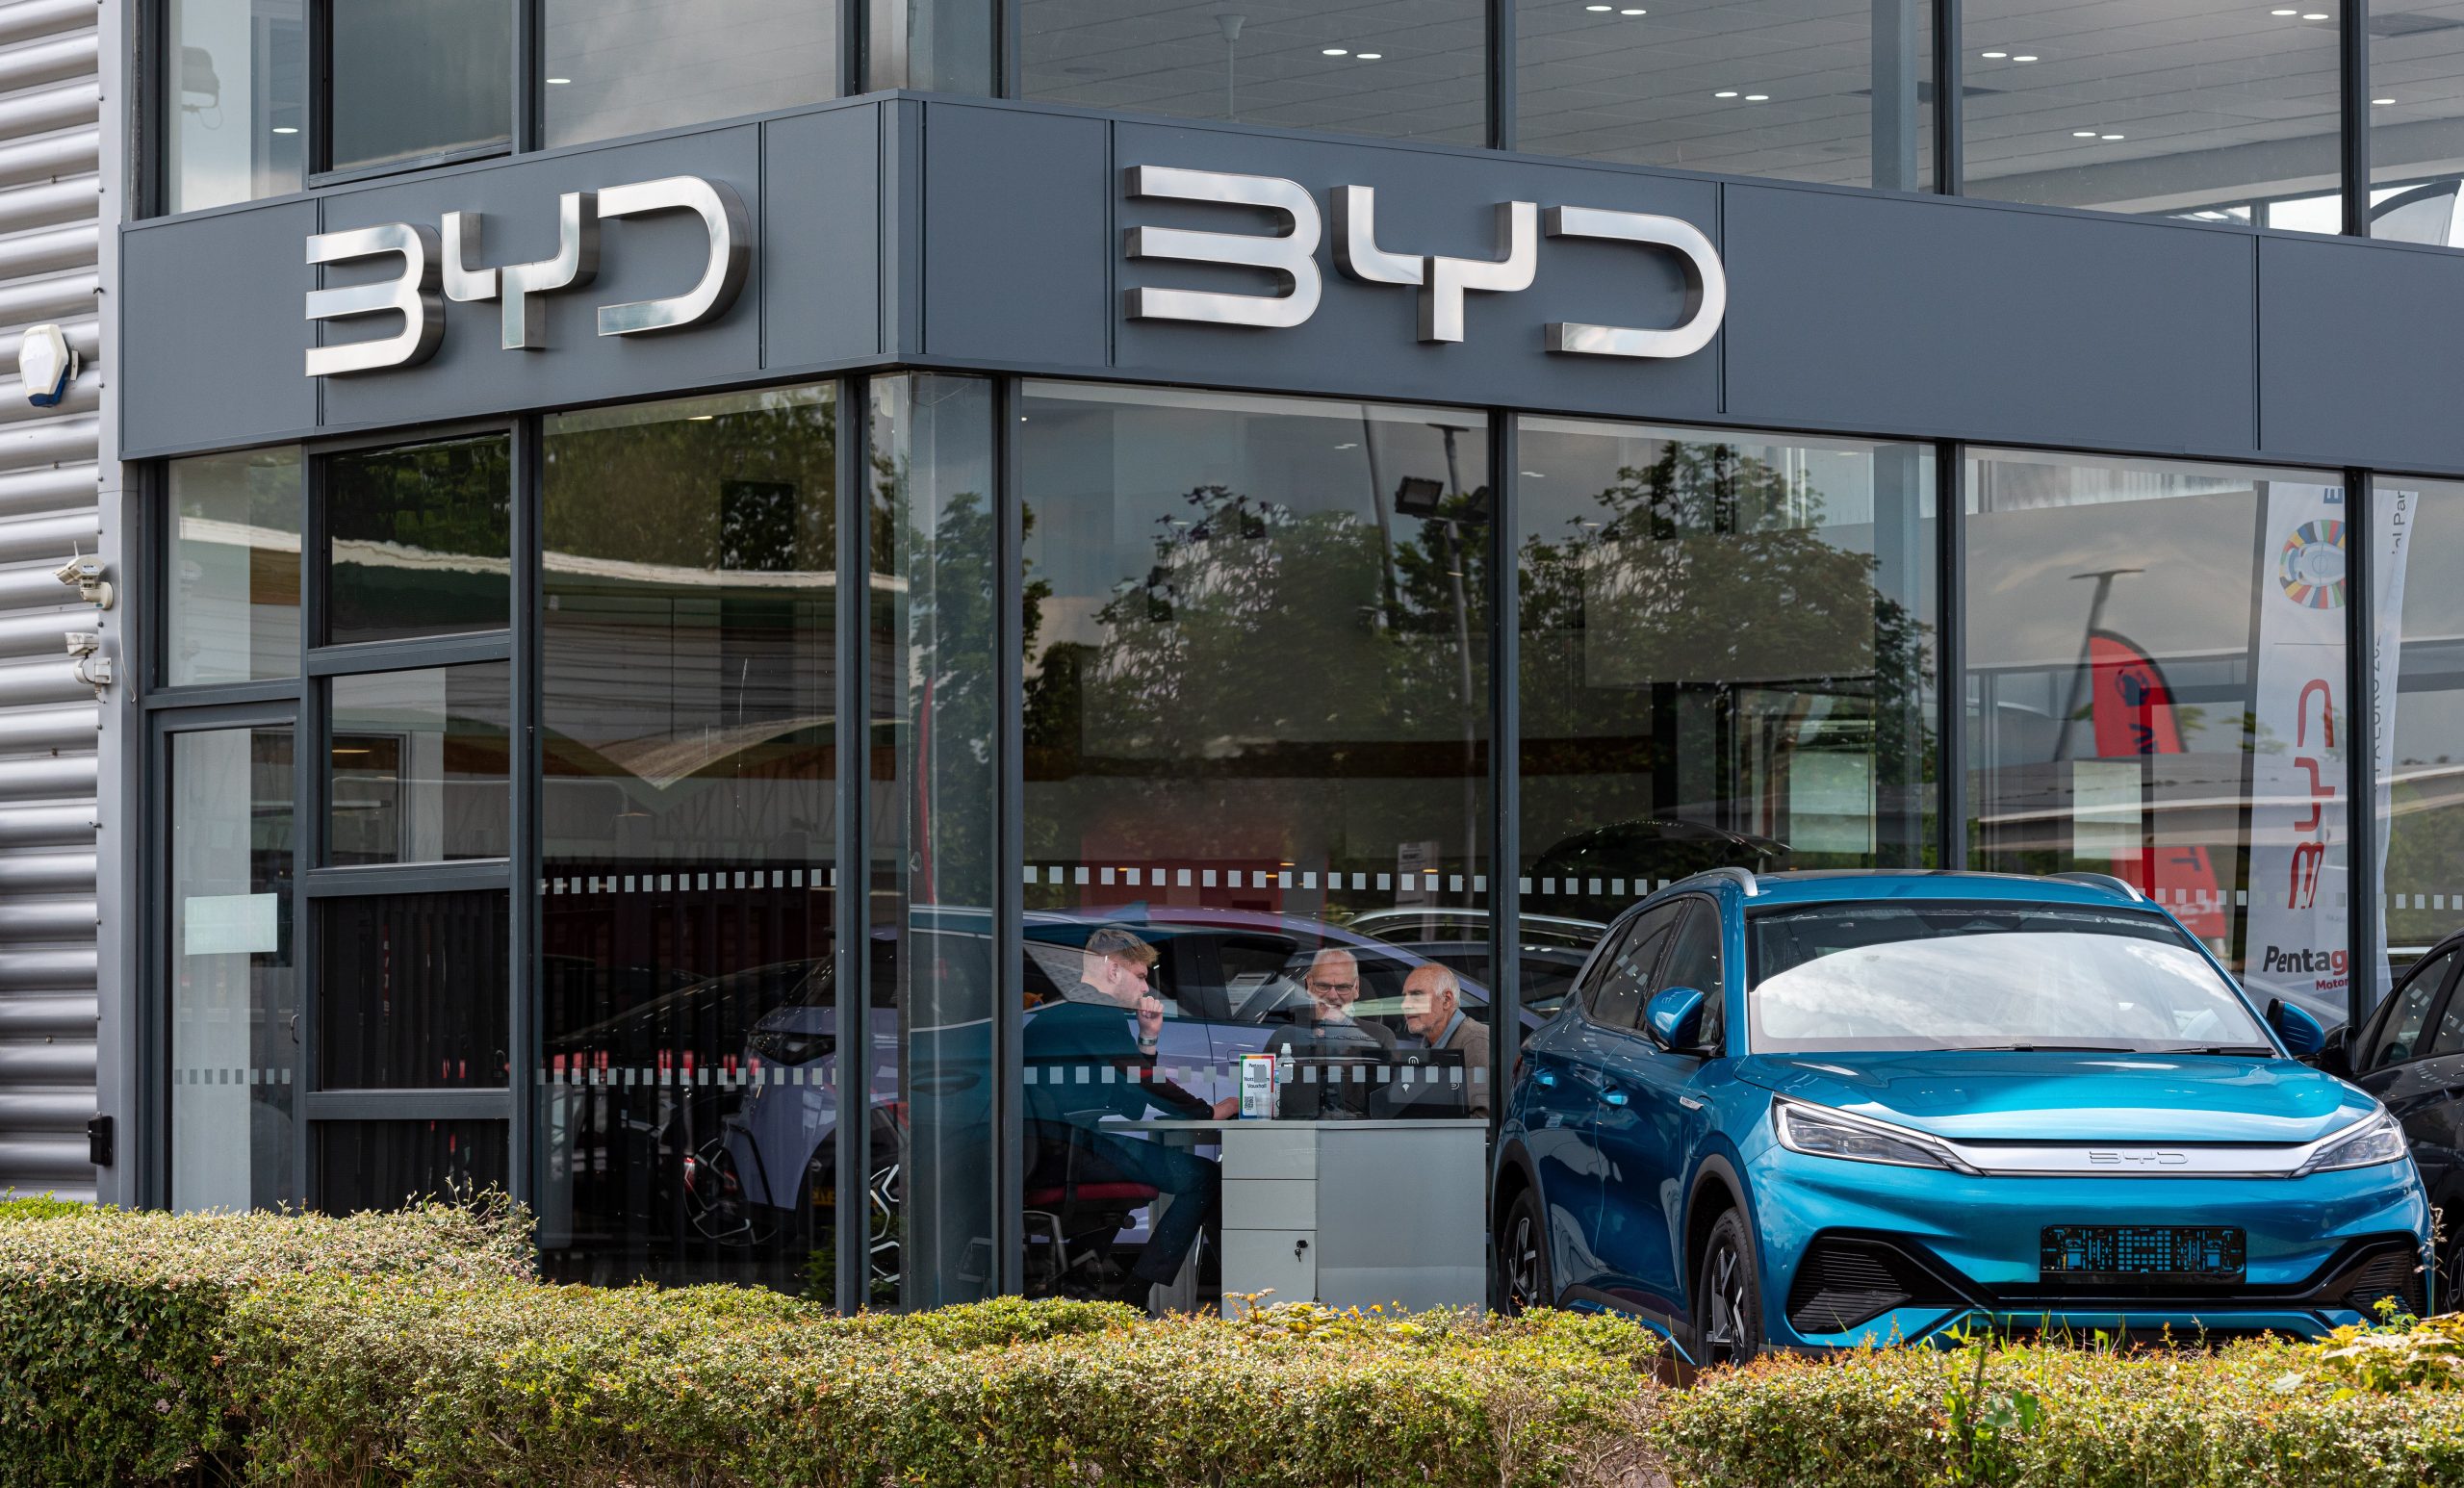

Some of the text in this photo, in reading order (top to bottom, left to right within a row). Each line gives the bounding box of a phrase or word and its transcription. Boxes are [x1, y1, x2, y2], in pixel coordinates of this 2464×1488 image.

[305, 174, 752, 377] BYD
[1124, 165, 1728, 360] BYD
[2262, 945, 2348, 977] Pentag
[2088, 1150, 2189, 1165] BYD
